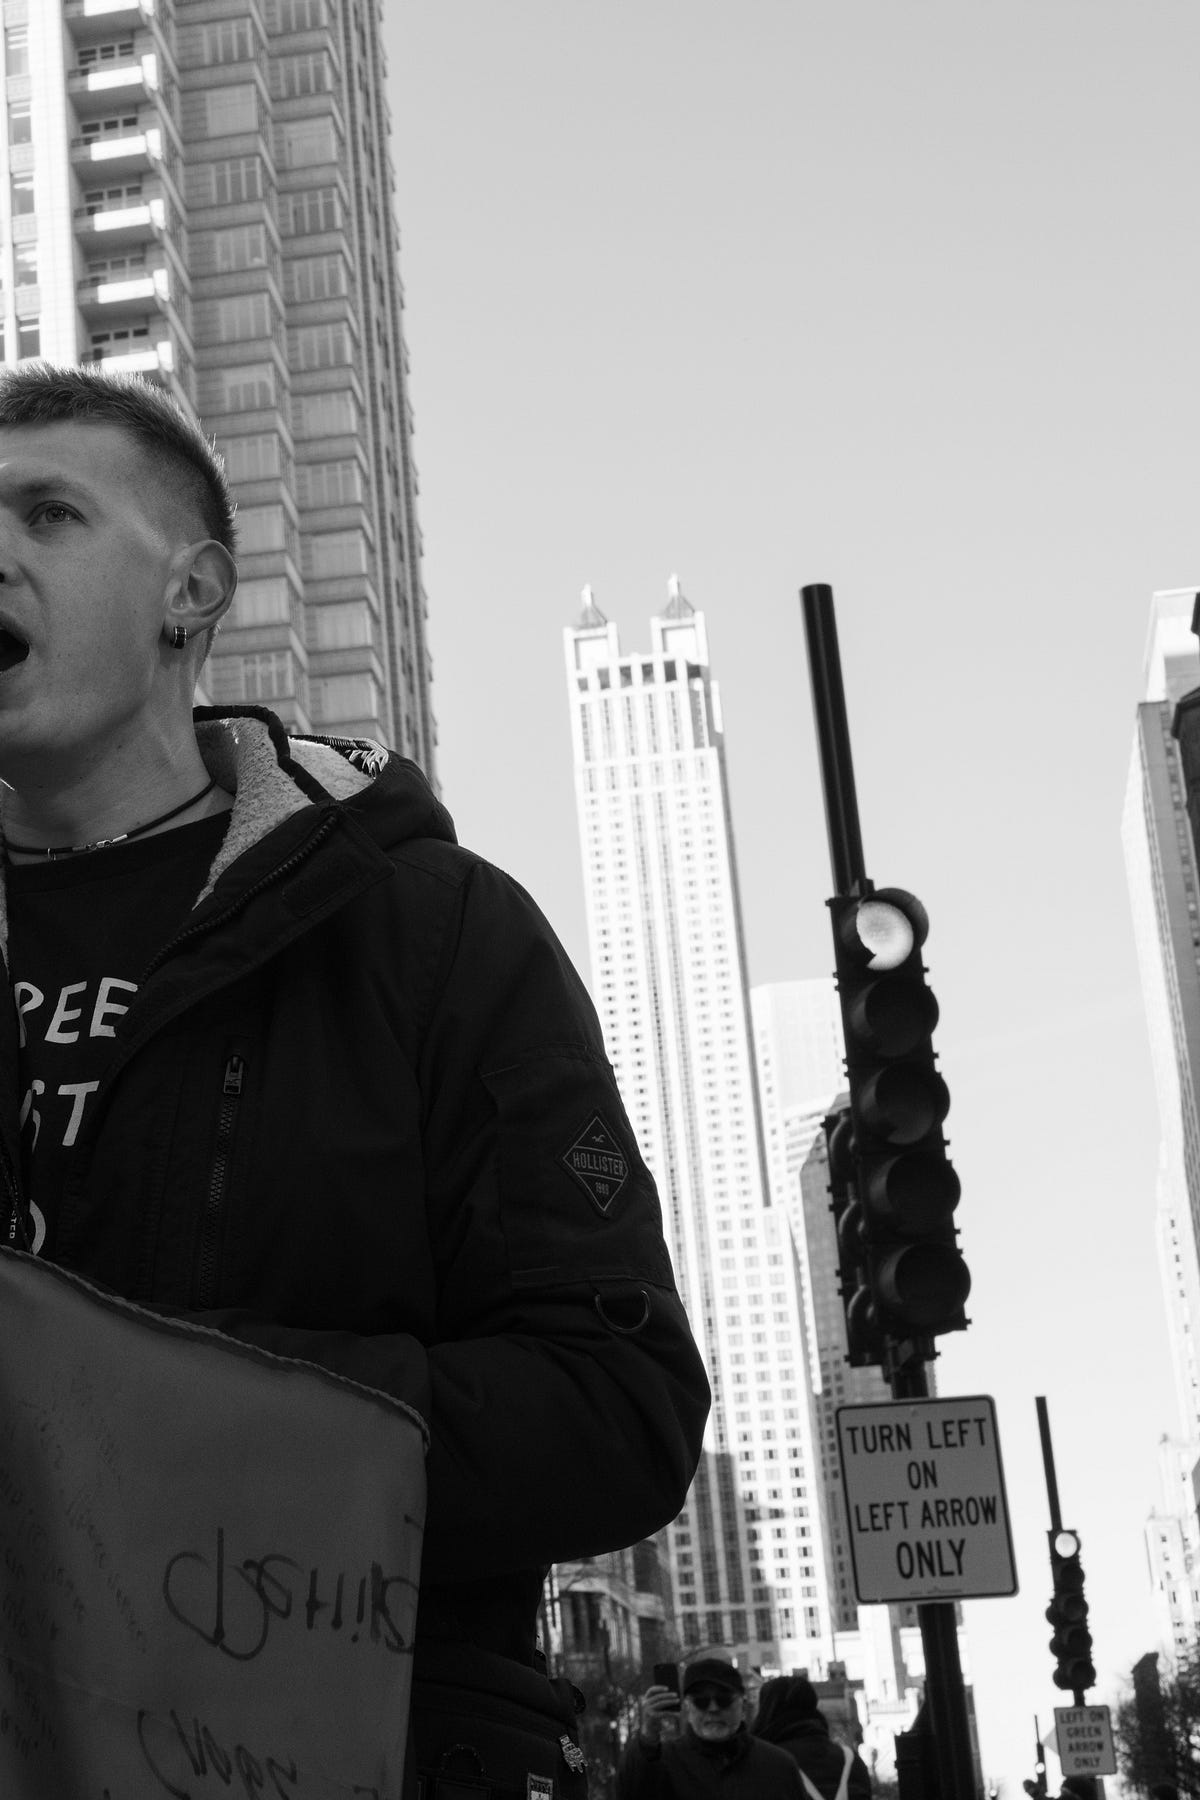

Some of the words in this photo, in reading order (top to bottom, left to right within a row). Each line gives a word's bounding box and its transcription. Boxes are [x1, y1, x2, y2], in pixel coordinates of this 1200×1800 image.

[572, 1152, 624, 1176] HOLLISTER
[846, 1421, 912, 1456] TURN
[927, 1416, 988, 1449] LEFT
[907, 1459, 939, 1491] ON
[854, 1501, 910, 1533] LEFT
[921, 1495, 998, 1528] ARROW
[895, 1538, 967, 1579] ONLY
[1059, 1710, 1084, 1724] LEFT
[1089, 1709, 1105, 1722] ON
[1066, 1726, 1102, 1738] GREEN
[1067, 1741, 1104, 1753] ARROW
[1074, 1756, 1100, 1768] ONLY
